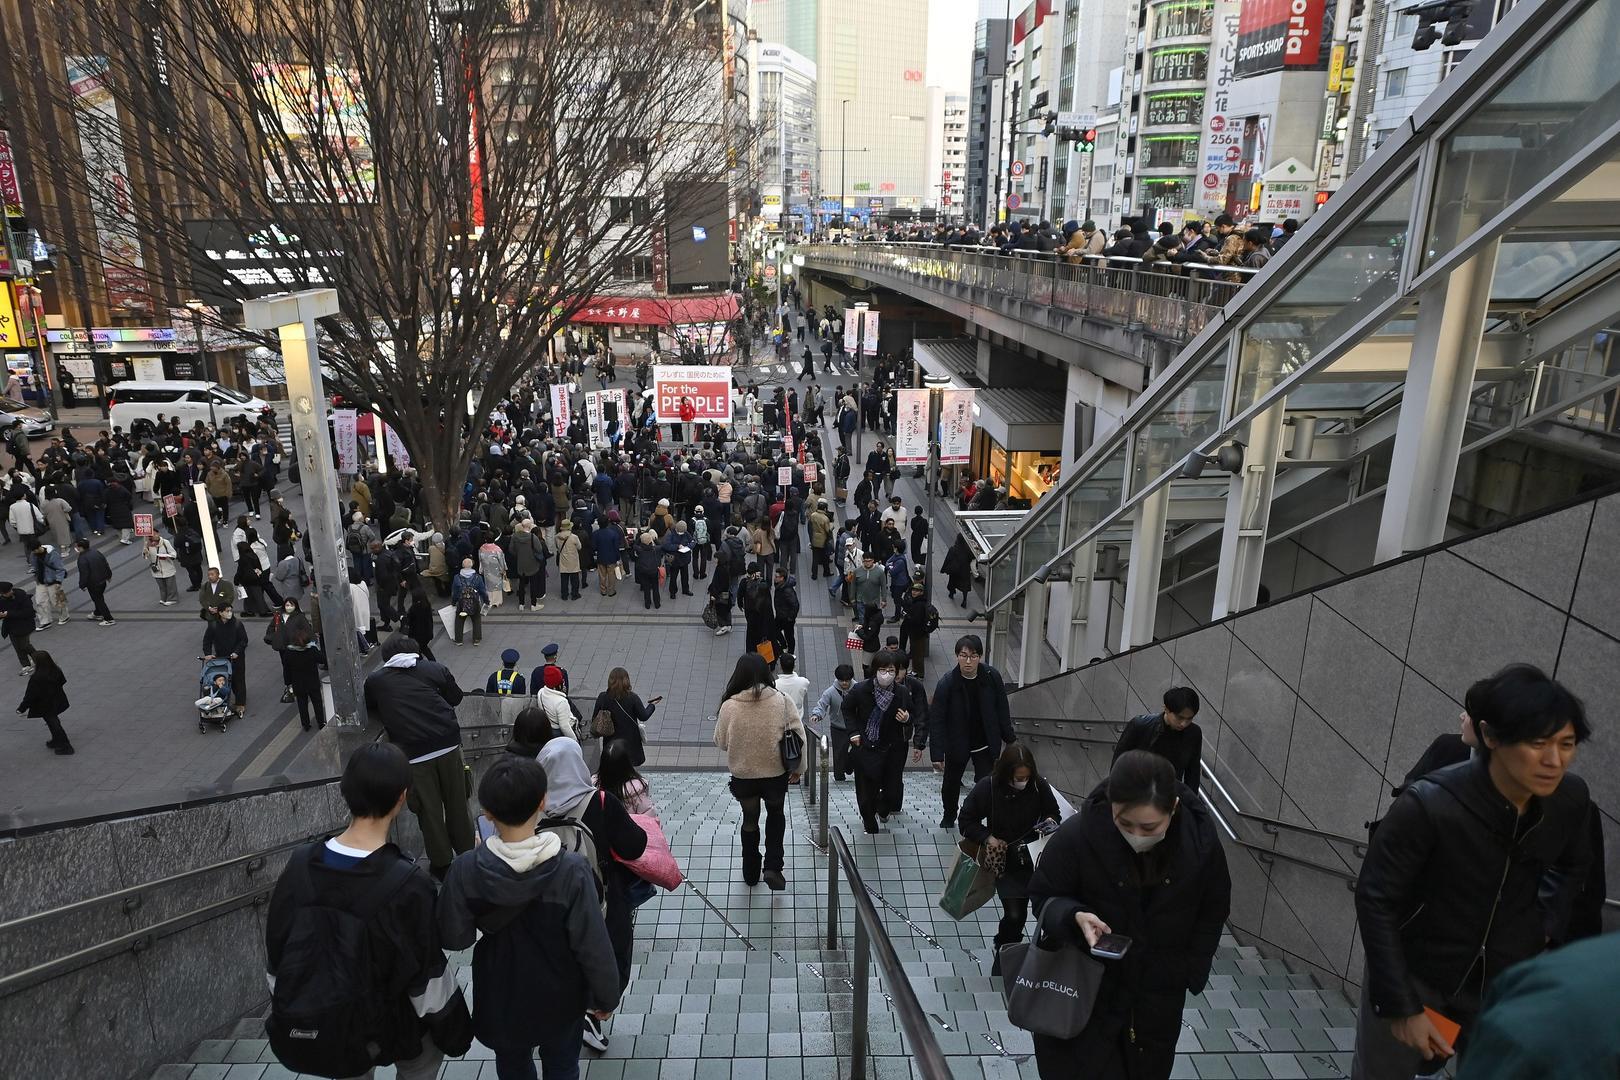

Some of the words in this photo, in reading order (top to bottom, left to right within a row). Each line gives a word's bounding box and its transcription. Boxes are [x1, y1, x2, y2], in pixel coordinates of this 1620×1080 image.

[1239, 42, 1264, 62] SPORTS
[1264, 37, 1284, 56] SHOP
[1154, 54, 1195, 68] CAPSULE
[1267, 200, 1300, 208] 広告募集
[662, 384, 678, 394] For
[680, 384, 698, 394] the
[587, 396, 599, 445] 田村智子
[1042, 981, 1079, 998] DELUCA
